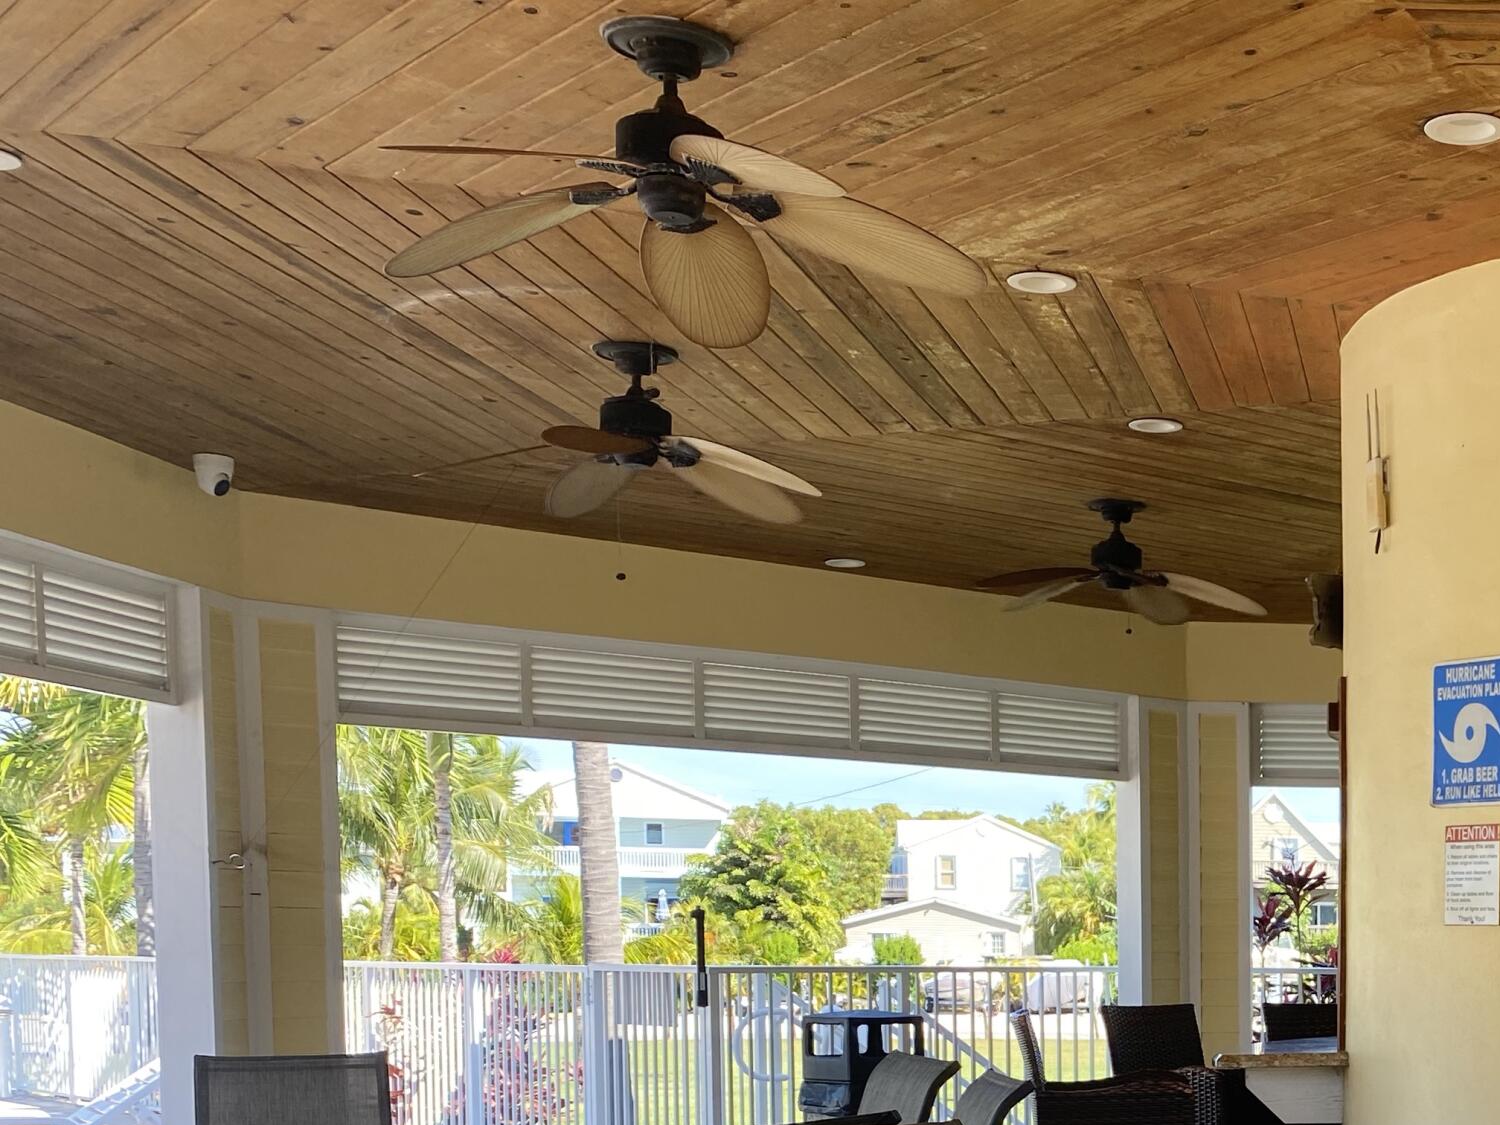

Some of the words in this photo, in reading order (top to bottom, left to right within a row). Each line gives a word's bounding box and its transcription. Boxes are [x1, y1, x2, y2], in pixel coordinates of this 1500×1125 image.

[1446, 663, 1496, 684] HURRICANE
[1437, 684, 1483, 701] EVACUATION
[1441, 768, 1449, 784] 1.
[1451, 767, 1474, 784] GRAB
[1476, 766, 1498, 782] BEER
[1435, 787, 1444, 800] 2.
[1445, 786, 1461, 800] RUN
[1463, 784, 1481, 799] LIKE
